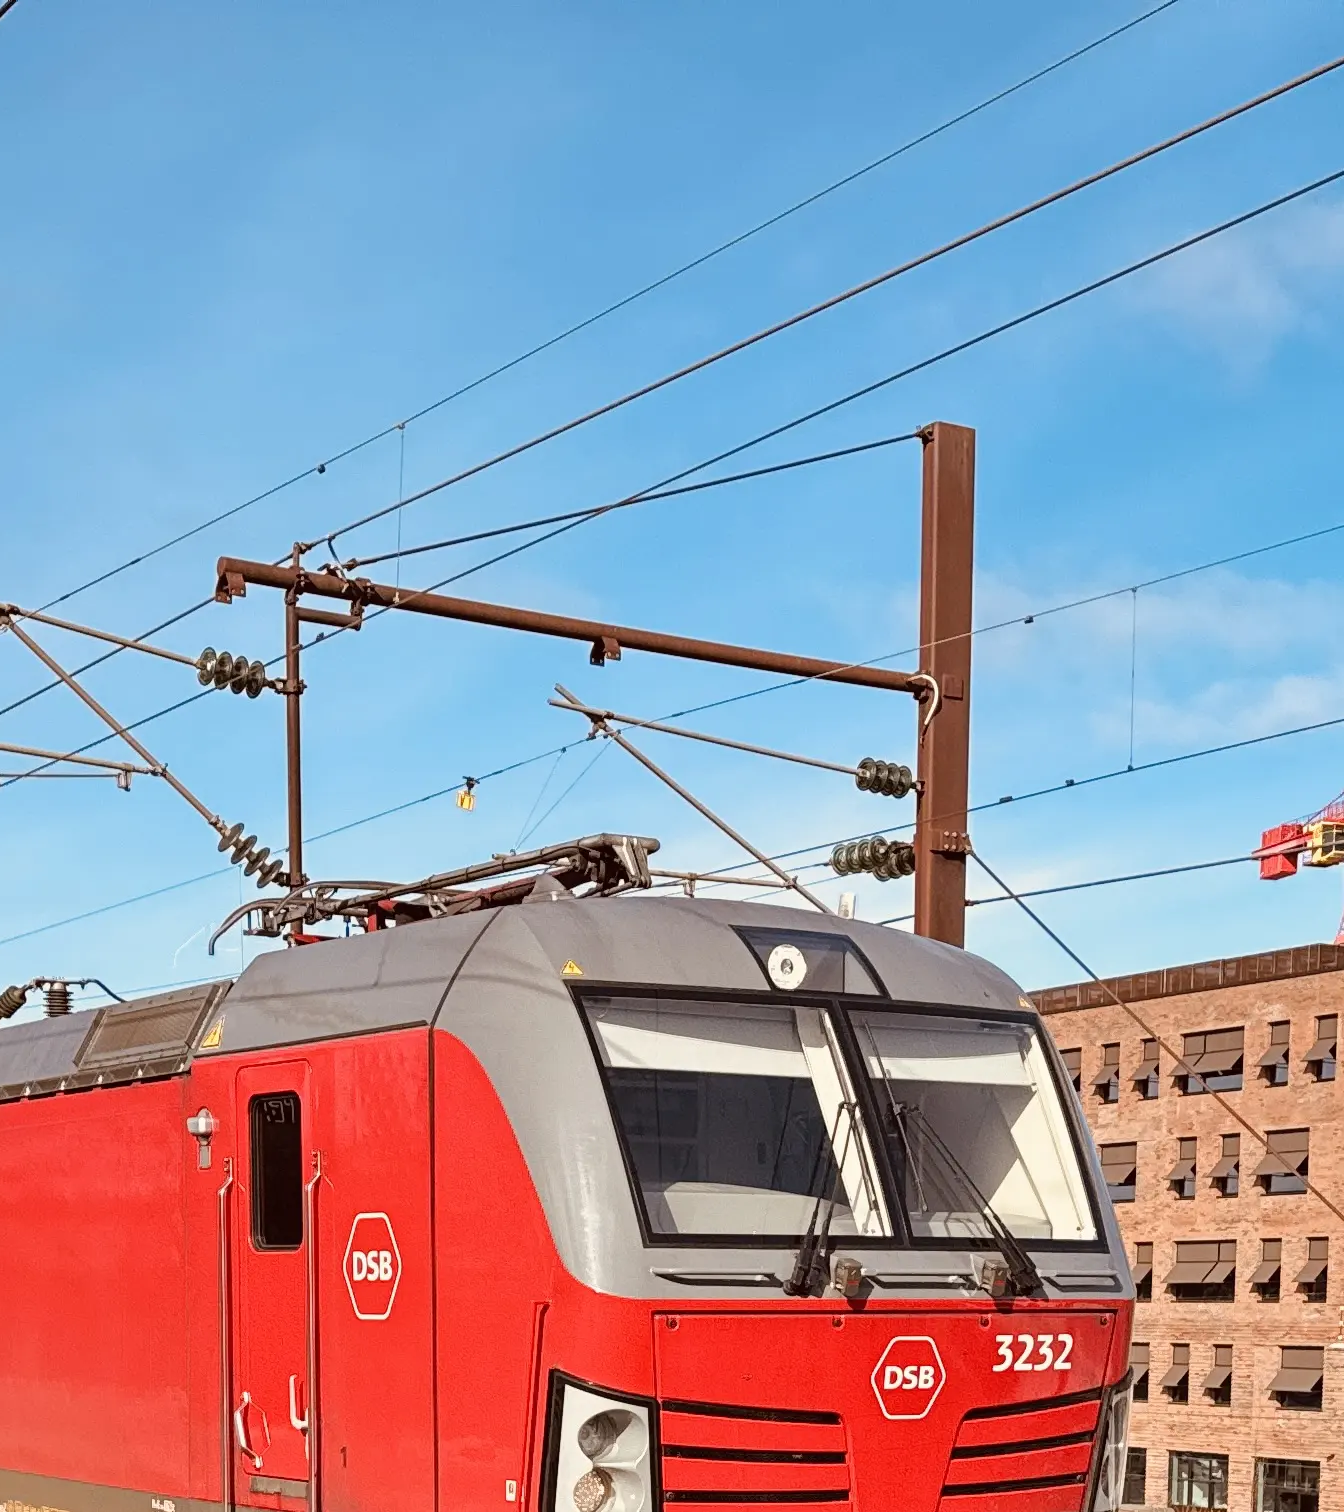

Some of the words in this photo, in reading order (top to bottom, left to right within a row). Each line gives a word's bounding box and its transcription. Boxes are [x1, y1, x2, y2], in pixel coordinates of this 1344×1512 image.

[352, 1250, 393, 1281] DSB
[992, 1333, 1074, 1372] 3232
[883, 1365, 935, 1390] DSB
